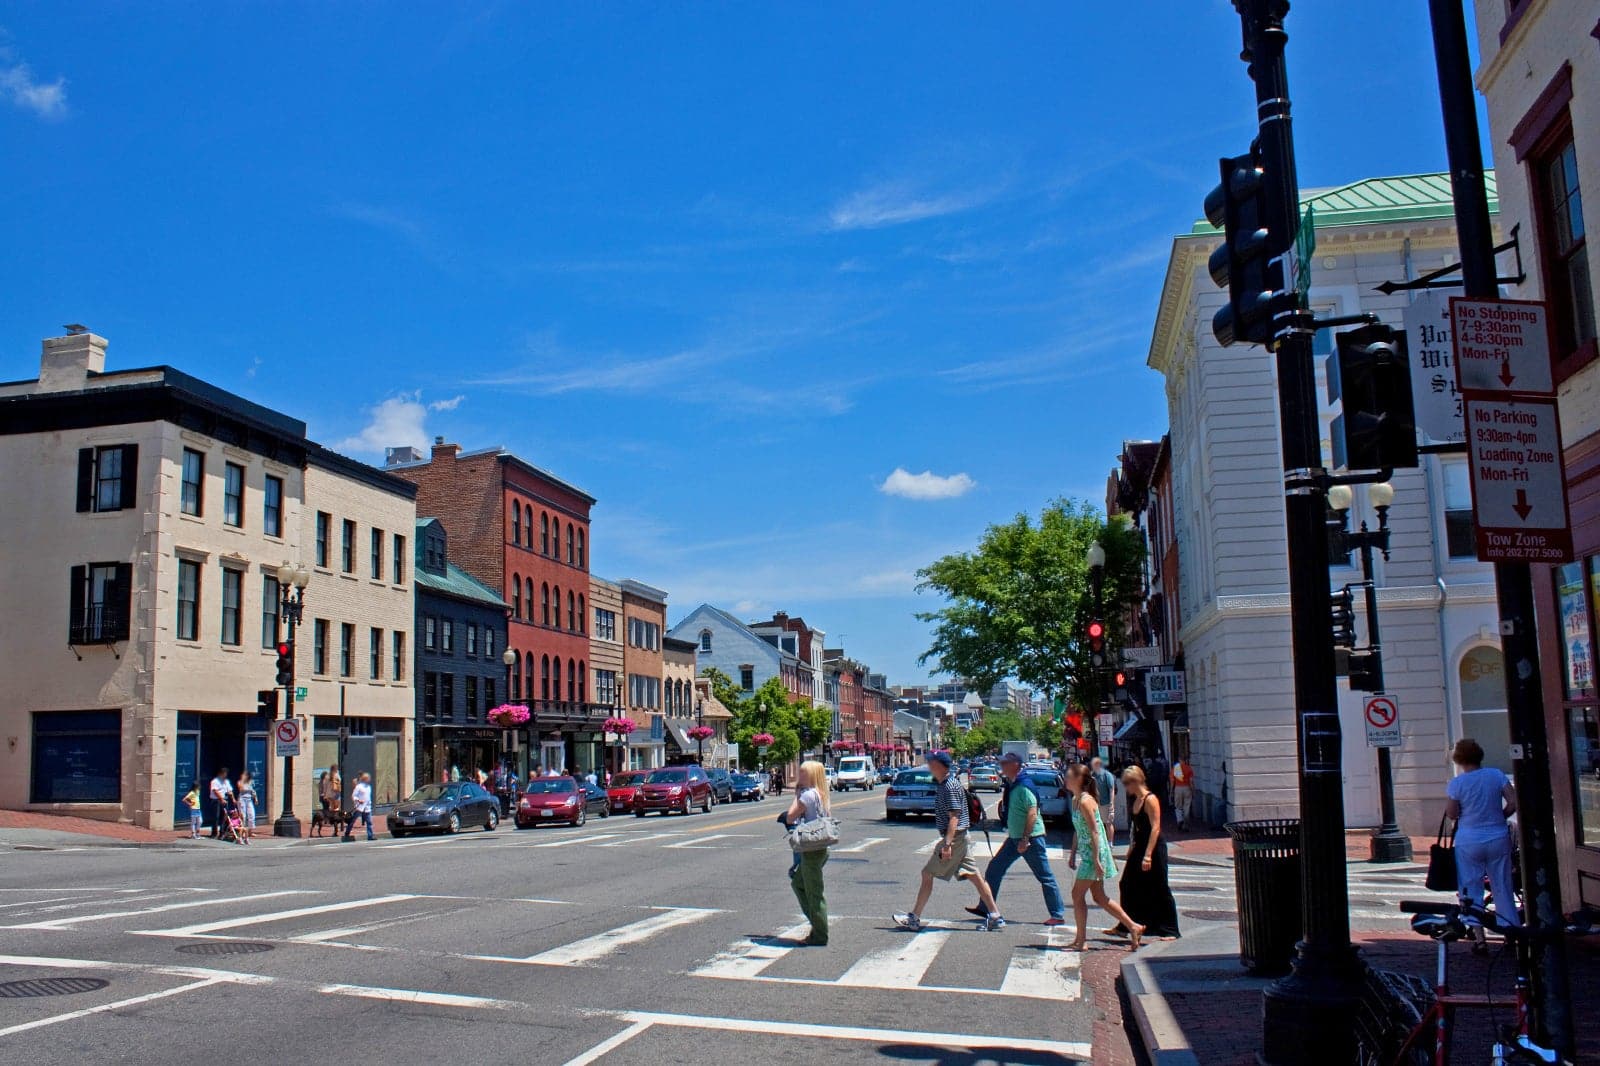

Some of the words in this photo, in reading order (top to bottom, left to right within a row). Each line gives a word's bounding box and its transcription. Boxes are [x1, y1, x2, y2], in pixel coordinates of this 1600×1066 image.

[1459, 306, 1476, 319] No
[1480, 307, 1537, 323] Stopping
[1460, 320, 1521, 334] 7-9:30am
[1461, 333, 1523, 347] 4-6:30pm
[1462, 347, 1510, 360] Mon-Fri
[1475, 408, 1490, 422] No
[1493, 409, 1537, 426] Parking
[1477, 430, 1537, 444] 9:30am-4pm
[1479, 448, 1524, 464] Loading
[1527, 449, 1554, 463] Zone
[1480, 467, 1529, 481] Mon-Fri
[1486, 532, 1512, 546] Tow
[1516, 533, 1546, 546] Zone
[1487, 547, 1505, 557] Info
